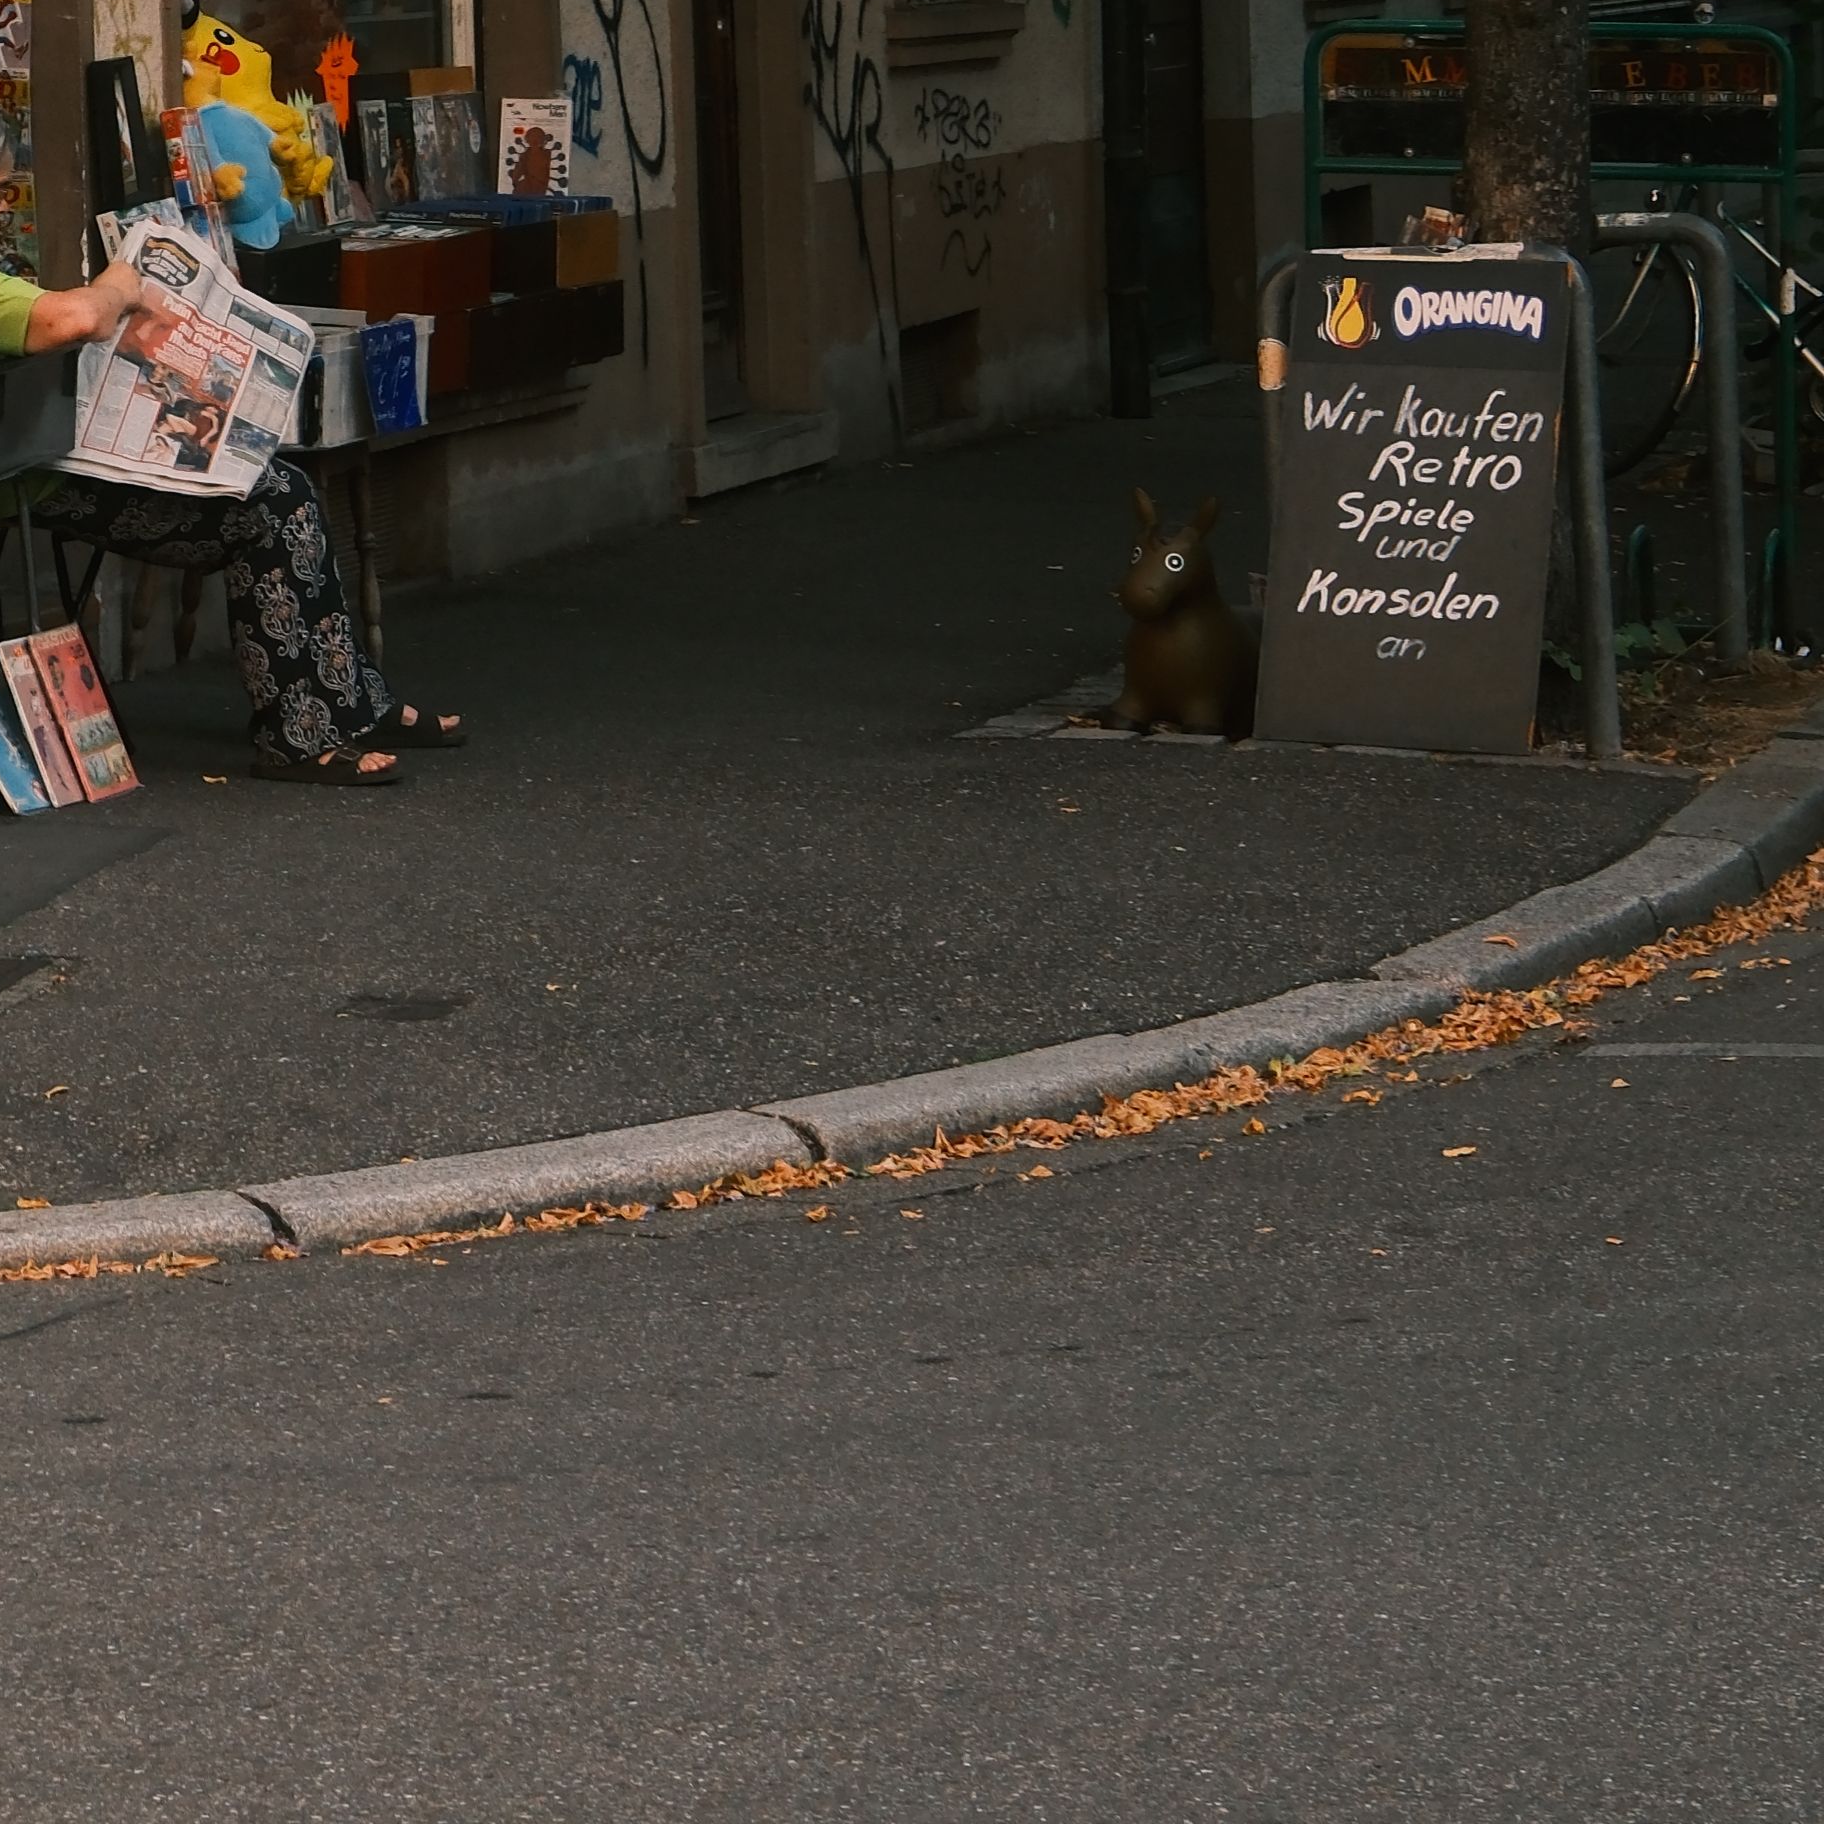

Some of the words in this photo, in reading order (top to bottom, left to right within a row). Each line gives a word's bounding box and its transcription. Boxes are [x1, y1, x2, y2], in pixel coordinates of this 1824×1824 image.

[1393, 285, 1545, 340] ORANGINA
[1303, 383, 1384, 435] Wir
[1369, 441, 1523, 492] Retro
[1337, 492, 1475, 543] Spiele
[1376, 535, 1457, 562] und
[1297, 568, 1500, 621] Konsolen
[1376, 635, 1427, 660] an
